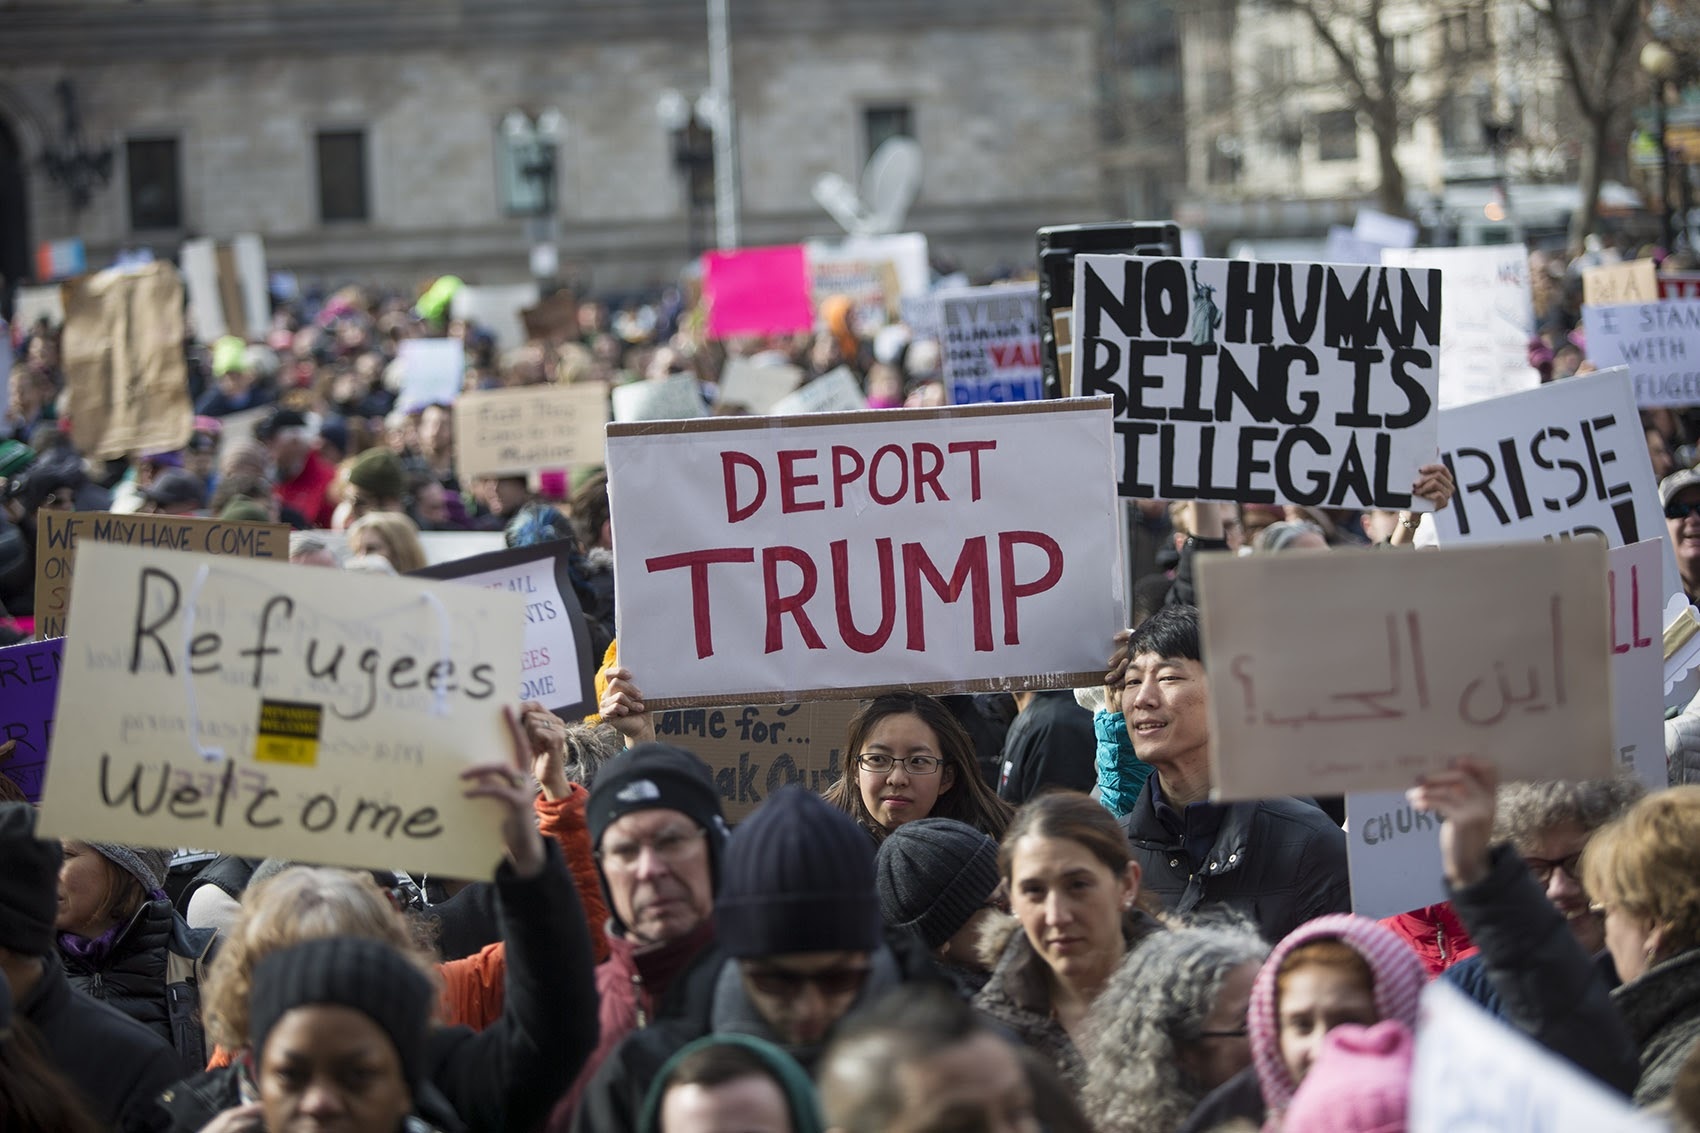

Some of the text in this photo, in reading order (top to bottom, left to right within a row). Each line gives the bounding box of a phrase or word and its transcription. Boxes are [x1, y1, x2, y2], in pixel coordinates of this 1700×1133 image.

[1084, 259, 1442, 348] NO HUMAN
[1082, 337, 1433, 430] BEING IS
[1617, 336, 1687, 364] WITH
[721, 440, 997, 524] DEPORT
[1115, 422, 1412, 508] ILLEGAL
[1441, 414, 1633, 536] RISE
[47, 516, 273, 557] WE MAY HAVE COME
[645, 530, 1064, 660] TRUMP
[129, 567, 494, 719] Refugees
[99, 754, 445, 839] Welcome
